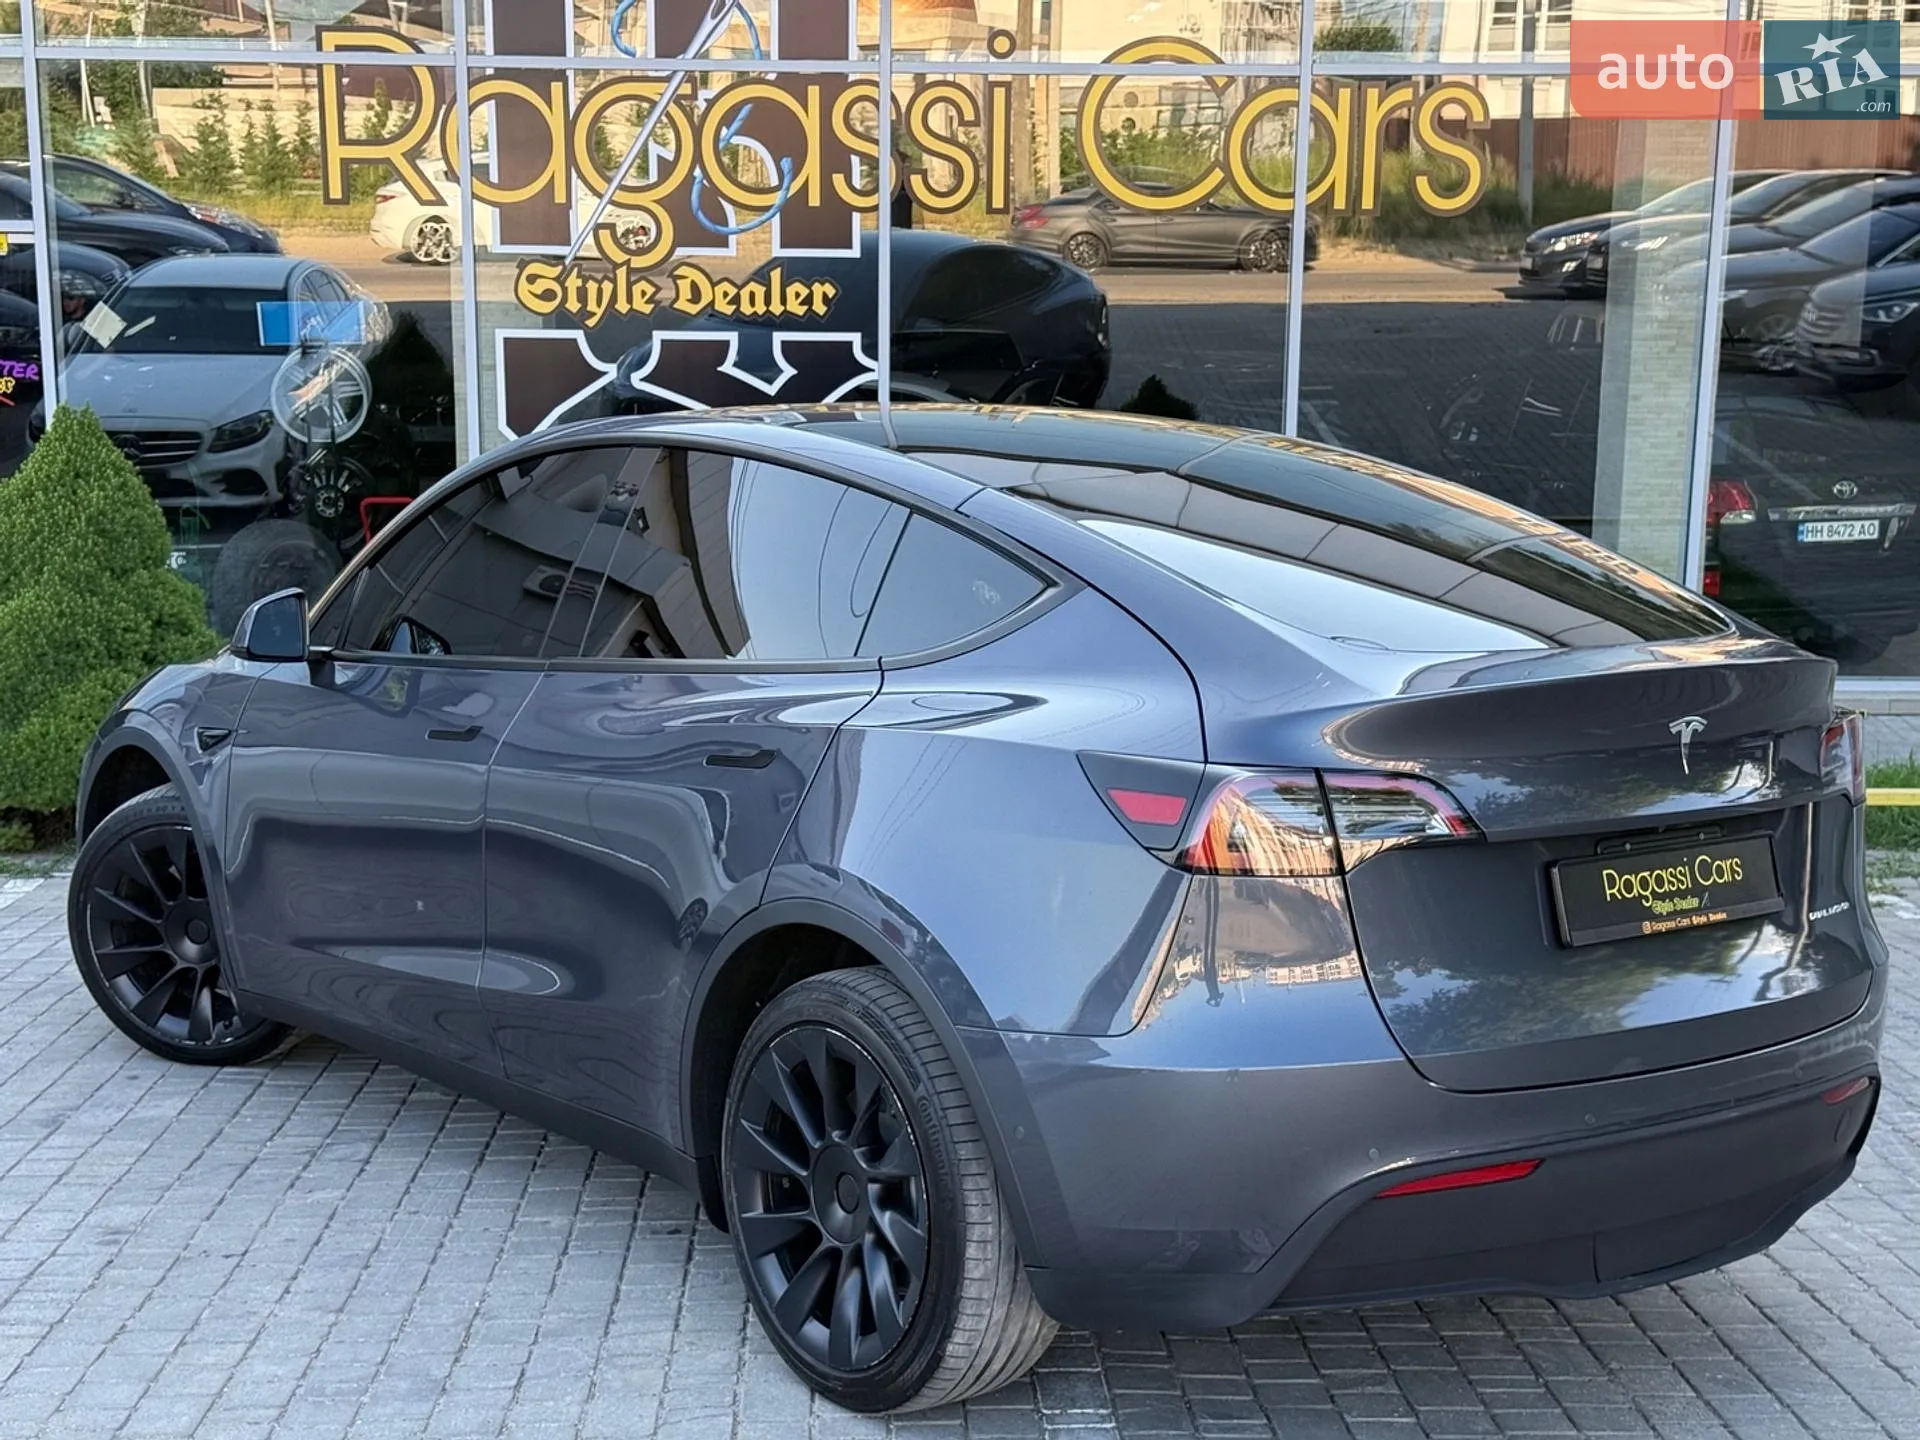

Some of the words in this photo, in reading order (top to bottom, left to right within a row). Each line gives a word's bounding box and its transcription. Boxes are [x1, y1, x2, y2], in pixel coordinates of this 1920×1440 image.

[317, 28, 1016, 270] Ragassi
[1078, 37, 1490, 217] Cars
[515, 254, 662, 330] Style
[668, 258, 840, 322] Dealer
[1806, 524, 1824, 539] HH
[1826, 522, 1855, 538] 8472
[1858, 522, 1877, 537] AO
[1602, 856, 1692, 907] Ragassi
[1695, 855, 1743, 886] Cars
